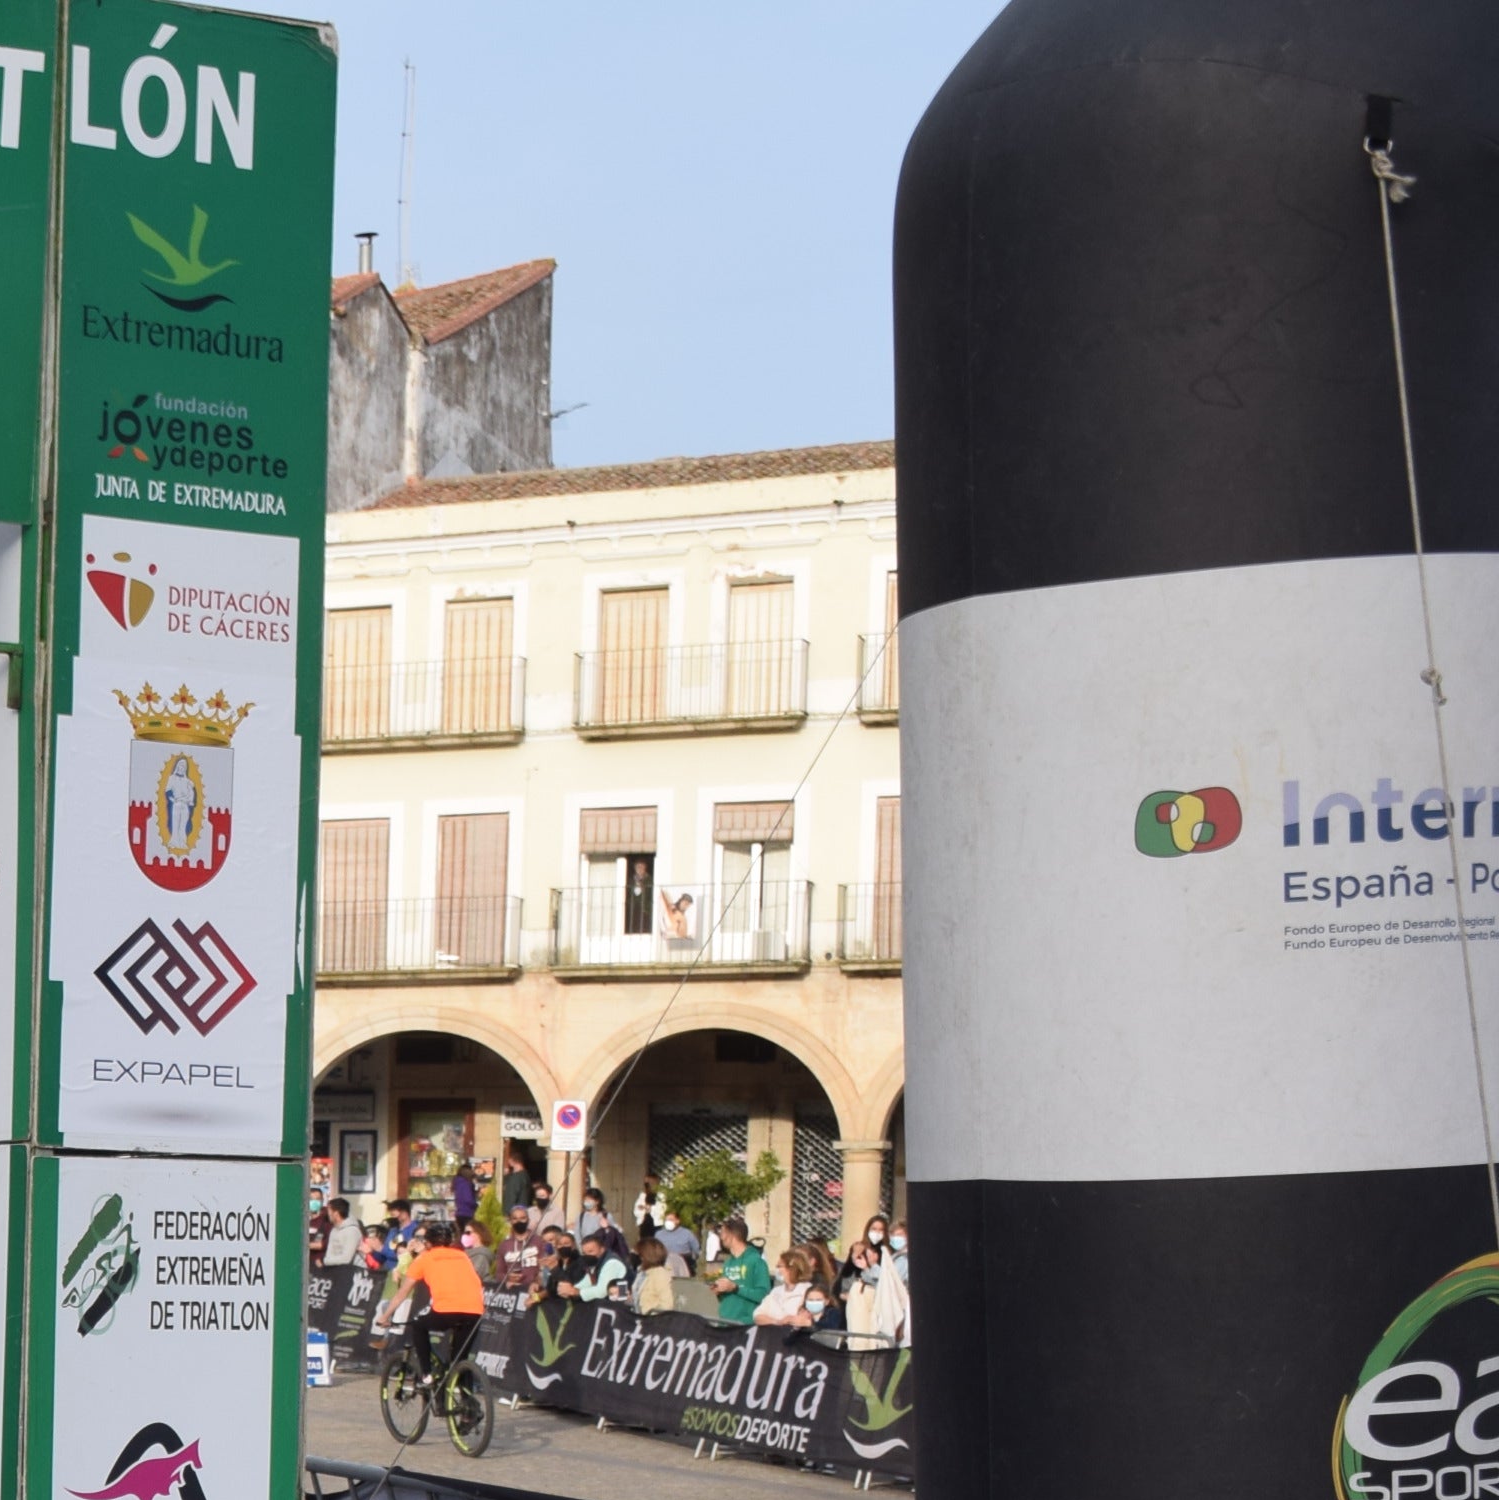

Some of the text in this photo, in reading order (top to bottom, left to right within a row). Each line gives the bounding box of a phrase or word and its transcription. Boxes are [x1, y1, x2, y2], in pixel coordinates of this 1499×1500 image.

[82, 304, 284, 363] Extremadura
[97, 394, 254, 451] jóvenes
[155, 391, 249, 421] fundación
[94, 473, 287, 517] JUNTA DE EXTREMADURA
[168, 584, 291, 618] DIPUTACIÓN
[167, 611, 291, 643] DE CÁCERES
[1284, 865, 1434, 908] España
[1284, 916, 1496, 937] Fondo Europeo de Desarrollo egional
[1284, 938, 1326, 951] Fundo
[1328, 936, 1382, 950] Europeu
[1384, 934, 1400, 946] de
[92, 1059, 255, 1089] EXPAPEL
[153, 1206, 270, 1242] FEDERACIÓN
[155, 1250, 266, 1286] EXTREMEÑA
[150, 1301, 270, 1331] DE TRIATLON
[580, 1307, 829, 1421] Extremadura
[681, 1405, 812, 1454] #SOMOSDEPORTE
